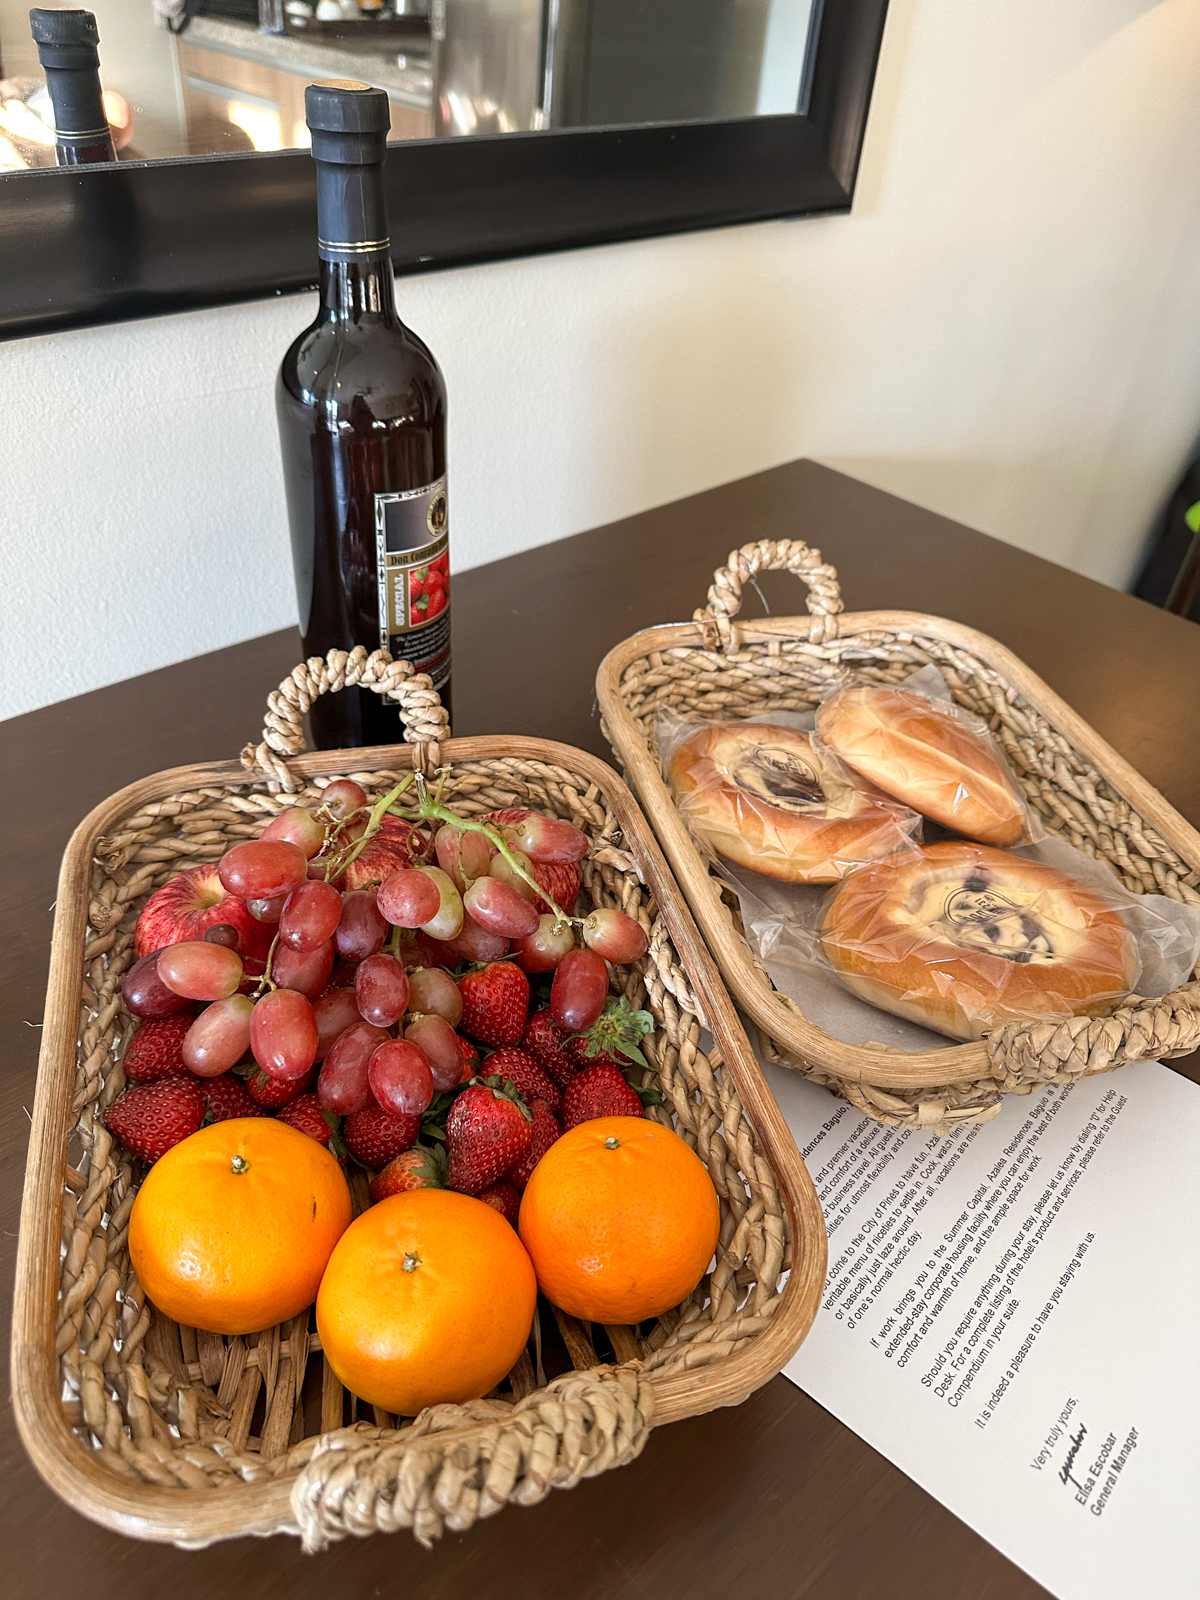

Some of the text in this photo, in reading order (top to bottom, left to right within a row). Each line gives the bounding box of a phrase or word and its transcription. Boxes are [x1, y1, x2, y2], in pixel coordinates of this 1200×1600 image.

[391, 556, 408, 566] Don
[394, 573, 406, 626] SPECIAL
[1047, 1100, 1063, 1115] both
[1095, 1103, 1109, 1114] for
[1101, 1089, 1117, 1106] Help
[1109, 1095, 1128, 1115] Guest
[822, 1107, 850, 1131] Baguio,
[1033, 1119, 1050, 1136] best
[1044, 1111, 1054, 1122] of
[1104, 1114, 1117, 1126] the
[1078, 1122, 1097, 1144] dialing
[1092, 1130, 1106, 1148] refer
[1099, 1124, 1110, 1133] to
[925, 1133, 941, 1152] Azal
[1026, 1134, 1040, 1147] the
[1070, 1142, 1084, 1155] by
[815, 1166, 830, 1184] and
[826, 1142, 850, 1171] premier
[818, 1184, 832, 1201] and
[829, 1160, 854, 1189] comfort
[849, 1151, 859, 1163] of
[859, 1127, 880, 1150] deluxe
[914, 1151, 931, 1165] fun,
[1016, 1144, 1033, 1164] enjoy
[1059, 1151, 1078, 1173] know
[1078, 1146, 1097, 1170] please
[826, 1178, 856, 1211] business
[850, 1158, 873, 1181] travel.
[868, 1146, 881, 1160] All
[876, 1129, 895, 1151] guest
[839, 1203, 853, 1216] for
[849, 1179, 872, 1205] utmost
[866, 1151, 895, 1182] flexibility
[890, 1137, 904, 1153] and
[900, 1163, 920, 1183] have
[1007, 1162, 1021, 1177] can
[1054, 1170, 1068, 1181] us
[894, 1180, 906, 1192] to
[997, 1175, 1012, 1192] you
[1046, 1178, 1060, 1193] let
[1059, 1169, 1085, 1198] services,
[879, 1188, 900, 1212] Pines
[983, 1189, 1003, 1212] where
[1033, 1189, 1053, 1216] please
[1051, 1195, 1065, 1213] and
[822, 1276, 851, 1310] veritable
[848, 1253, 869, 1279] menu
[865, 1242, 879, 1257] of
[872, 1216, 897, 1247] niceties
[891, 1208, 903, 1219] to
[899, 1188, 918, 1210] settle
[911, 1180, 926, 1190] in.
[919, 1160, 941, 1180] Cook,
[935, 1139, 955, 1160] watch
[869, 1337, 881, 1349] If
[878, 1316, 898, 1339] work
[892, 1288, 916, 1316] brings
[914, 1270, 929, 1289] you
[925, 1259, 936, 1270] to
[932, 1244, 947, 1259] the
[943, 1210, 970, 1243] Summer
[966, 1183, 991, 1210] Capital,
[986, 1158, 1008, 1183] Azalea
[1003, 1120, 1034, 1157] Residences
[1029, 1097, 1049, 1119] Baguio
[874, 1207, 885, 1221] of
[966, 1210, 989, 1235] facility
[1022, 1215, 1040, 1232] stay,
[834, 1308, 845, 1320] or
[840, 1273, 872, 1310] basically
[865, 1258, 883, 1278] just
[876, 1242, 895, 1261] laze
[892, 1214, 916, 1243] around.
[911, 1195, 929, 1216] After
[925, 1183, 939, 1197] all,
[932, 1153, 960, 1185] vacations
[957, 1141, 969, 1154] are
[861, 1216, 879, 1236] City
[1035, 1210, 1056, 1241] product
[844, 1246, 856, 1257] to
[851, 1233, 866, 1248] the
[946, 1233, 974, 1264] housing
[1010, 1230, 1026, 1251] your
[828, 1255, 850, 1282] come
[897, 1155, 1043, 1368] comfort and warmth of home, and the ample space for work.
[995, 1249, 1017, 1274] during
[1009, 1262, 1024, 1277] the
[847, 1316, 857, 1329] of
[870, 1266, 894, 1298] normal
[888, 1245, 910, 1270] hectic
[906, 1230, 922, 1247] day.
[924, 1263, 952, 1300] corporate
[974, 1273, 1001, 1308] anything
[1006, 1273, 1016, 1286] of
[988, 1284, 1012, 1310] listing
[884, 1299, 928, 1358] extended-stay
[954, 1308, 977, 1338] require
[968, 1309, 995, 1347] complete
[974, 1232, 1096, 1429] It is indeed a pleasure to have you staying with us.
[943, 1337, 958, 1358] you
[948, 1299, 1021, 1407] Compendium in your suite.
[963, 1346, 972, 1355] a
[921, 1353, 947, 1388] Should
[950, 1352, 967, 1372] For
[933, 1372, 957, 1398] Desk.
[1030, 1446, 1052, 1470] Very
[1044, 1424, 1064, 1448] truly
[1057, 1398, 1079, 1428] yours,
[1074, 1432, 1117, 1506] Elisa Escobar
[1090, 1427, 1138, 1516] General Manager
